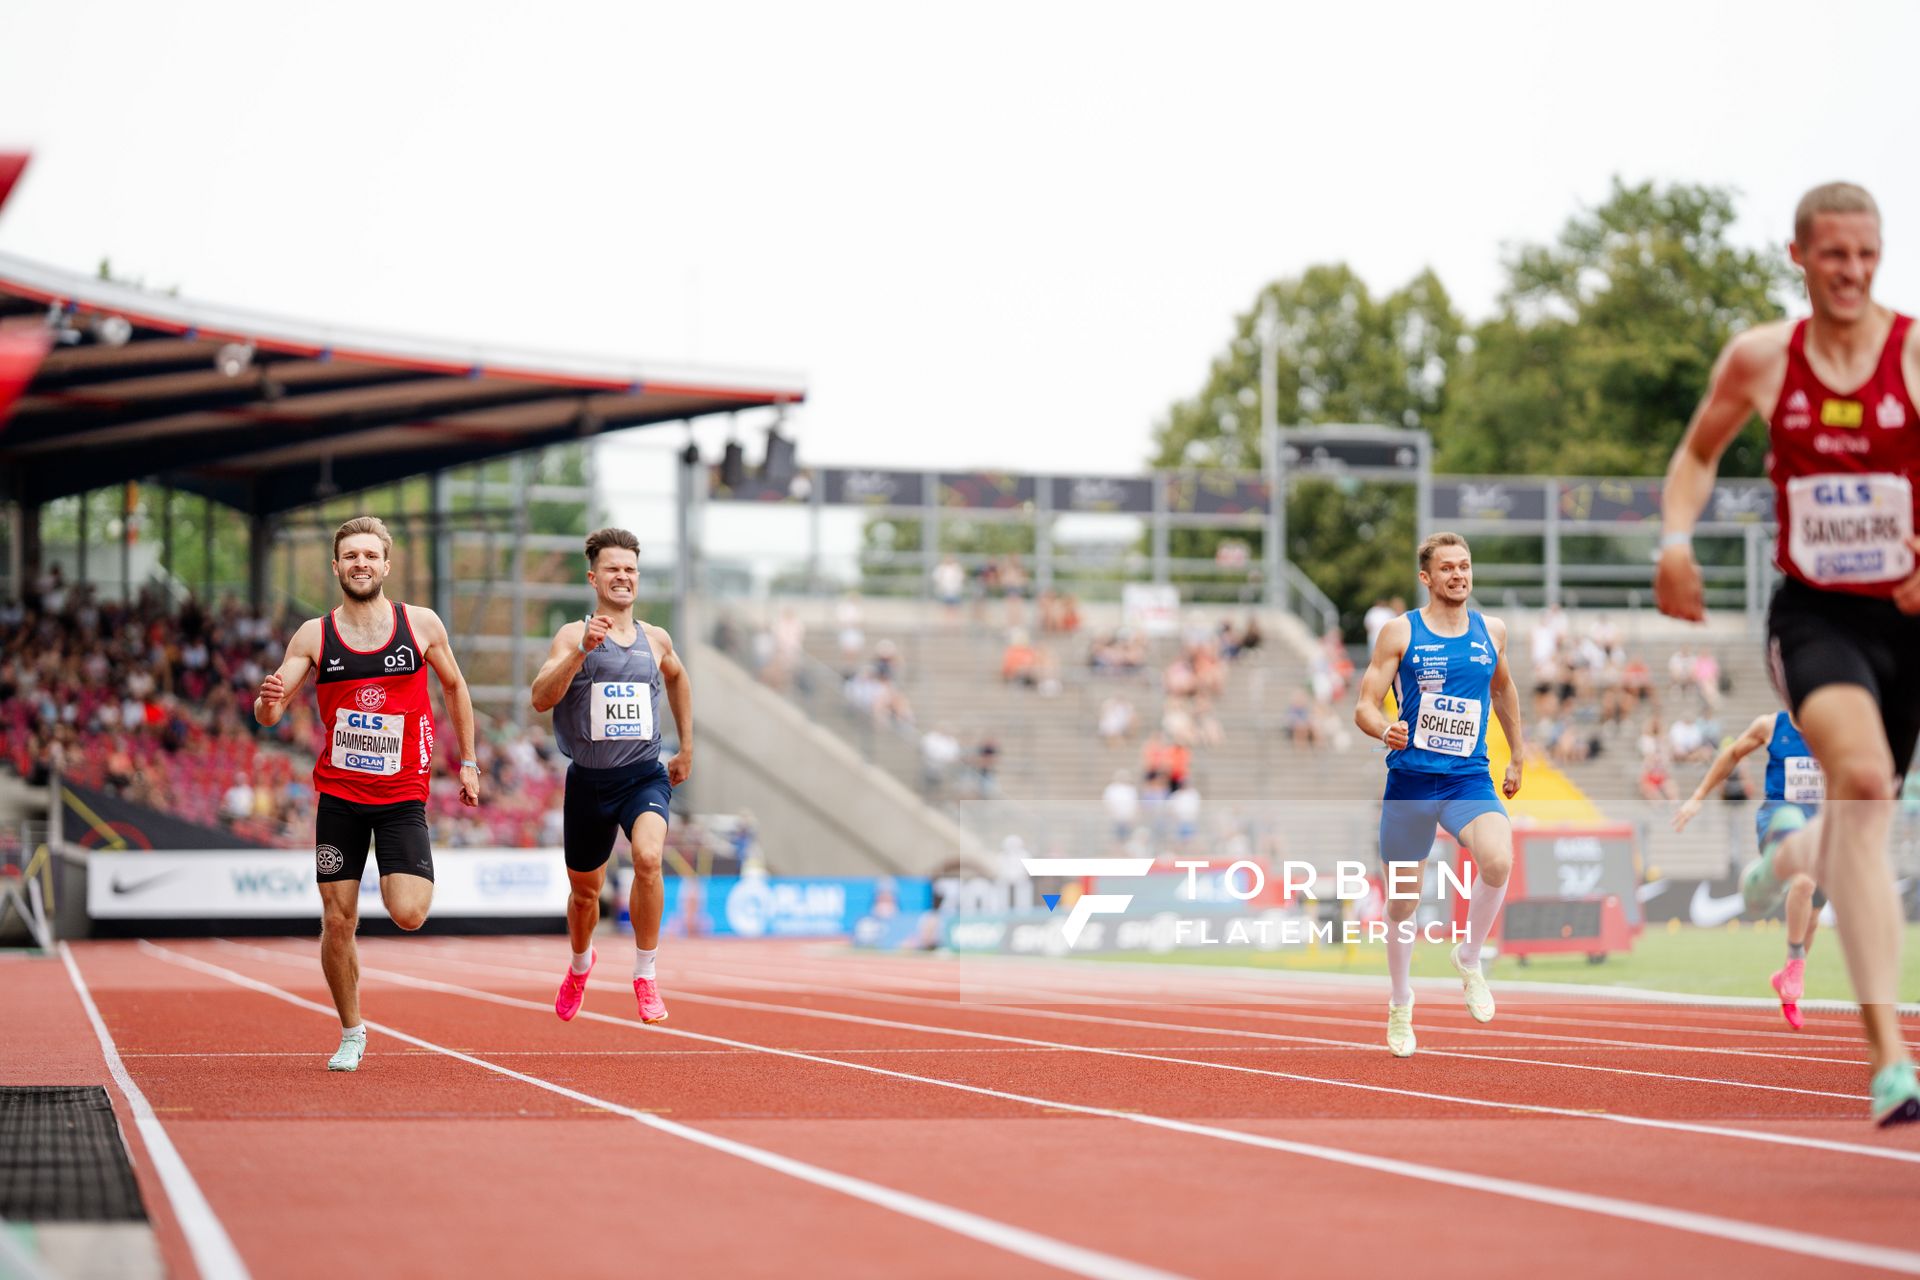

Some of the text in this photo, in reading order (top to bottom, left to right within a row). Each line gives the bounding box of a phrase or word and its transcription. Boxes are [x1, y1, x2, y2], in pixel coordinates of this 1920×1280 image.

[384, 654, 406, 667] OS
[605, 703, 640, 720] KLEI
[1420, 713, 1476, 737] SCHLEGEL
[335, 730, 400, 754] DAMMERMANN
[1442, 739, 1463, 748] PLAN
[360, 757, 383, 766] PLAN
